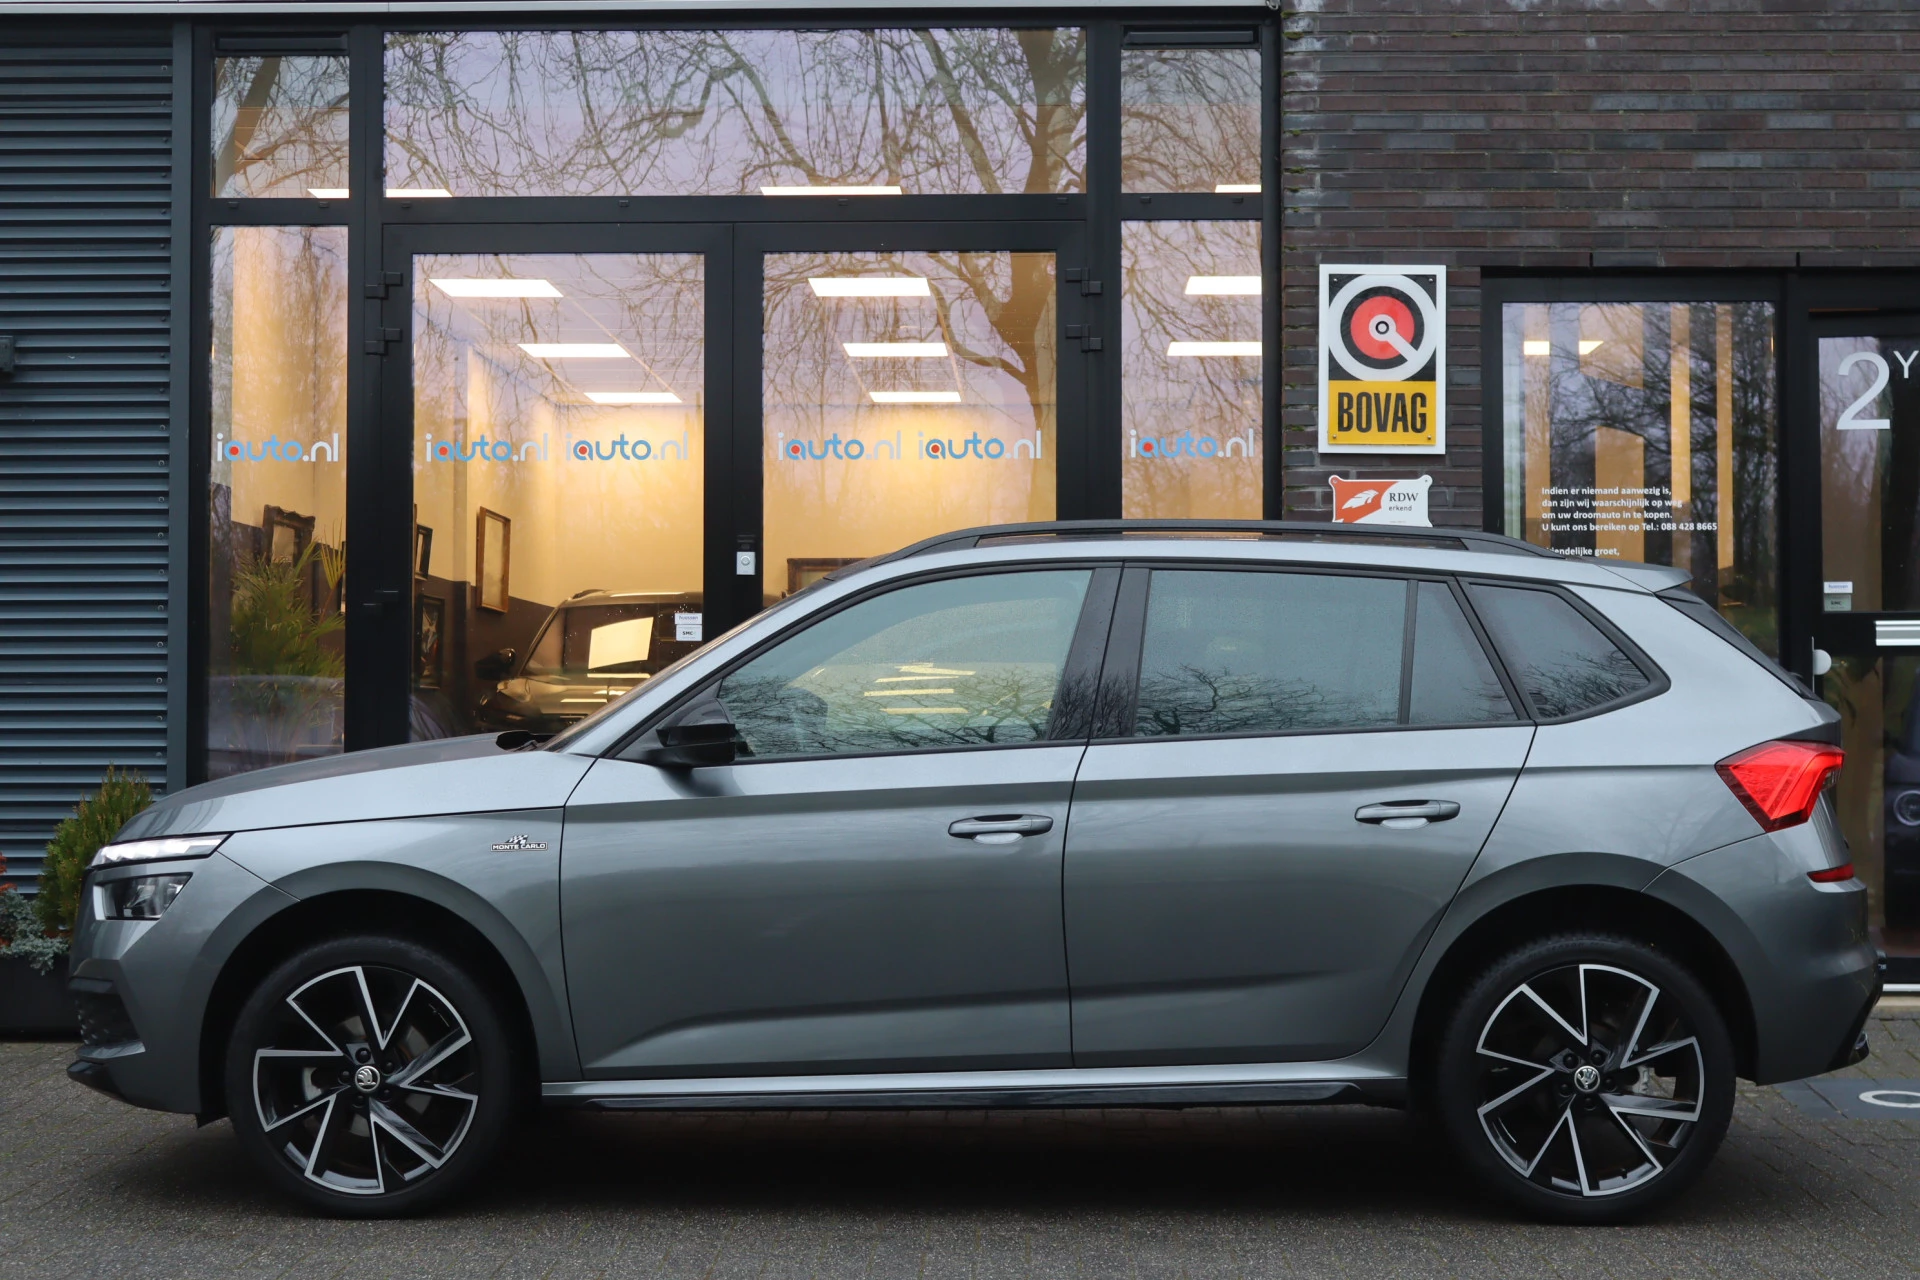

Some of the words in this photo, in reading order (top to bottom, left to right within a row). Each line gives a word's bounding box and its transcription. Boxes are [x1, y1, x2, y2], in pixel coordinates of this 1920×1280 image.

[1337, 392, 1427, 433] BOVAG
[216, 433, 339, 462] iauto.nl
[425, 432, 548, 462] iauto.nl
[565, 432, 688, 461] iauto.nl
[778, 430, 901, 460] iauto.nl
[918, 430, 1042, 460] iauto.nl
[1130, 428, 1254, 458] iauto.nl
[1389, 492, 1419, 502] RDW
[1541, 487, 1568, 495] Indien
[1581, 487, 1619, 495] niemand
[1621, 487, 1660, 496] aanwezig
[1662, 486, 1672, 496] is,
[1541, 499, 1558, 507] dan
[1560, 499, 1575, 508] zijn
[1576, 499, 1590, 508] wij
[1591, 499, 1650, 508] waarschijnlijk
[1651, 500, 1663, 508] op
[1665, 500, 1683, 508] weg
[1541, 523, 1549, 531] U
[1550, 523, 1570, 531] kunt
[1589, 523, 1627, 531] bereiken
[1628, 524, 1640, 532] op
[1642, 523, 1659, 531] Tel.:
[1660, 523, 1677, 531] 088
[1679, 523, 1695, 531] 428
[1696, 523, 1718, 531] 8665
[1573, 511, 1621, 519] droomauto
[1622, 511, 1631, 519] in
[1643, 511, 1673, 520] kopen.
[1594, 547, 1620, 557] groet,
